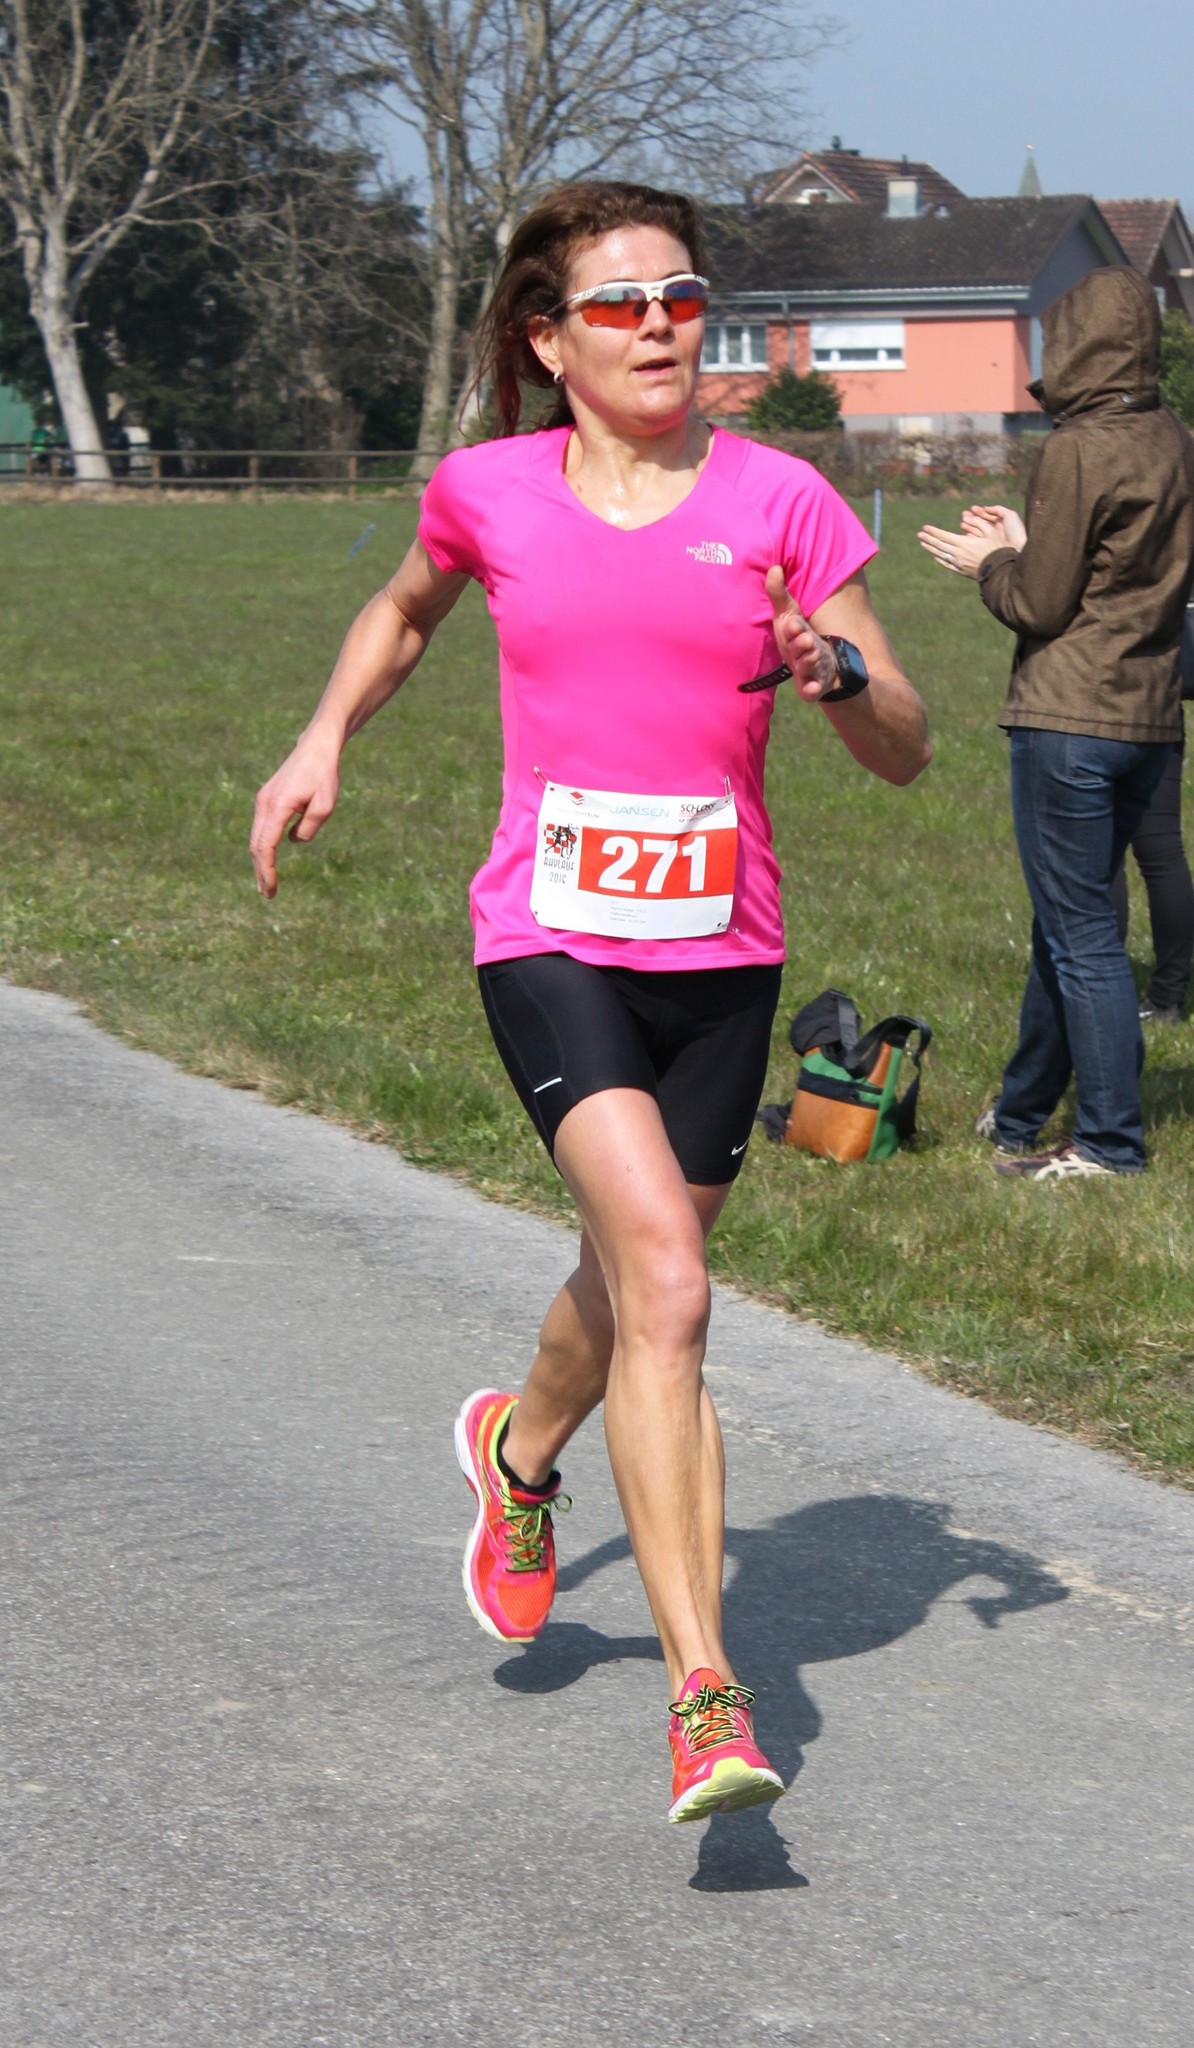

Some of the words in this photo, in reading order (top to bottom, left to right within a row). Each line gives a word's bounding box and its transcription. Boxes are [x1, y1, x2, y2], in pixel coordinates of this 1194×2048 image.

[701, 541, 717, 550] THE
[686, 546, 717, 557] NORTH
[694, 553, 717, 564] FACE
[608, 805, 670, 817] JANSEN
[598, 835, 707, 894] 271
[549, 872, 567, 884] 2016
